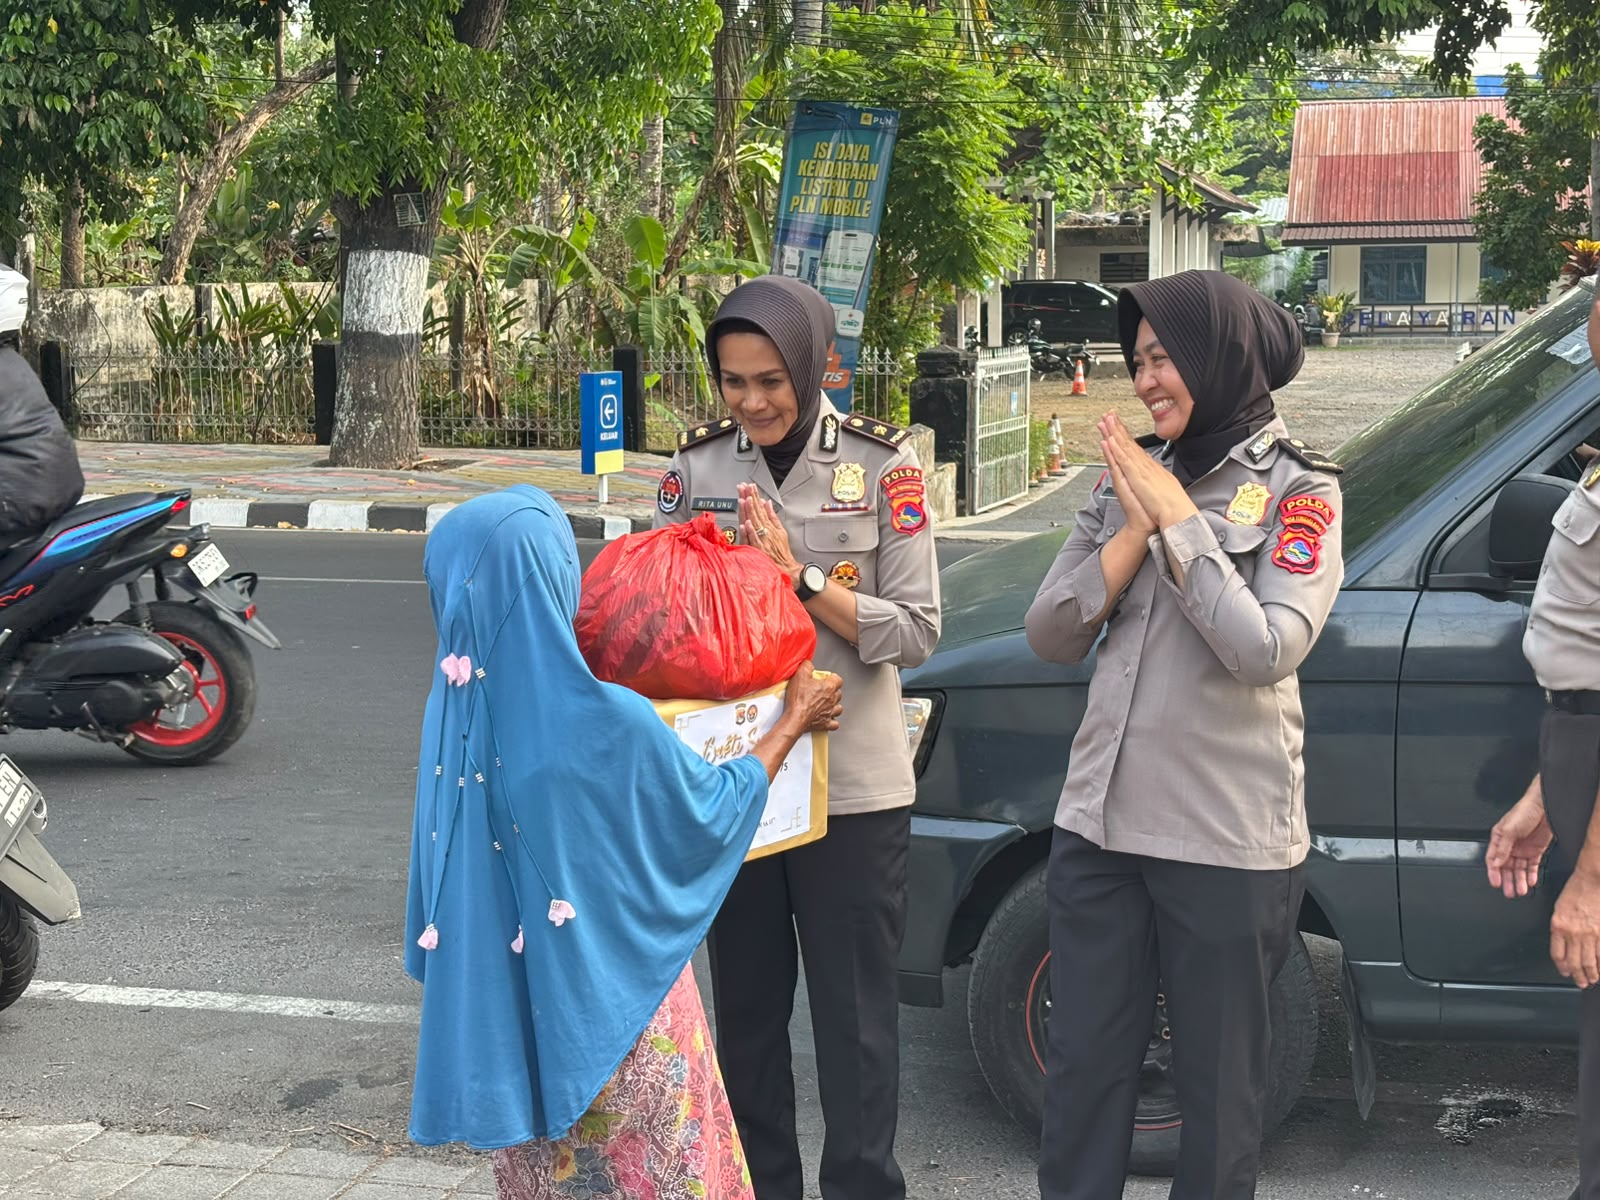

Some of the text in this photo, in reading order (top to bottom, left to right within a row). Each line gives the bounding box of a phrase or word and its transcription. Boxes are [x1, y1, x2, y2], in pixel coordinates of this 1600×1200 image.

[873, 116, 893, 126] PLN
[813, 142, 871, 161] ISI DAYA
[798, 159, 879, 181] KENDARAAN
[800, 178, 868, 199] LISTRIK DI
[789, 196, 872, 218] PLN MOBILE
[822, 371, 845, 382] TIS
[884, 468, 920, 484] POLDA
[697, 500, 715, 508] RITA
[1286, 497, 1330, 520] POLDA
